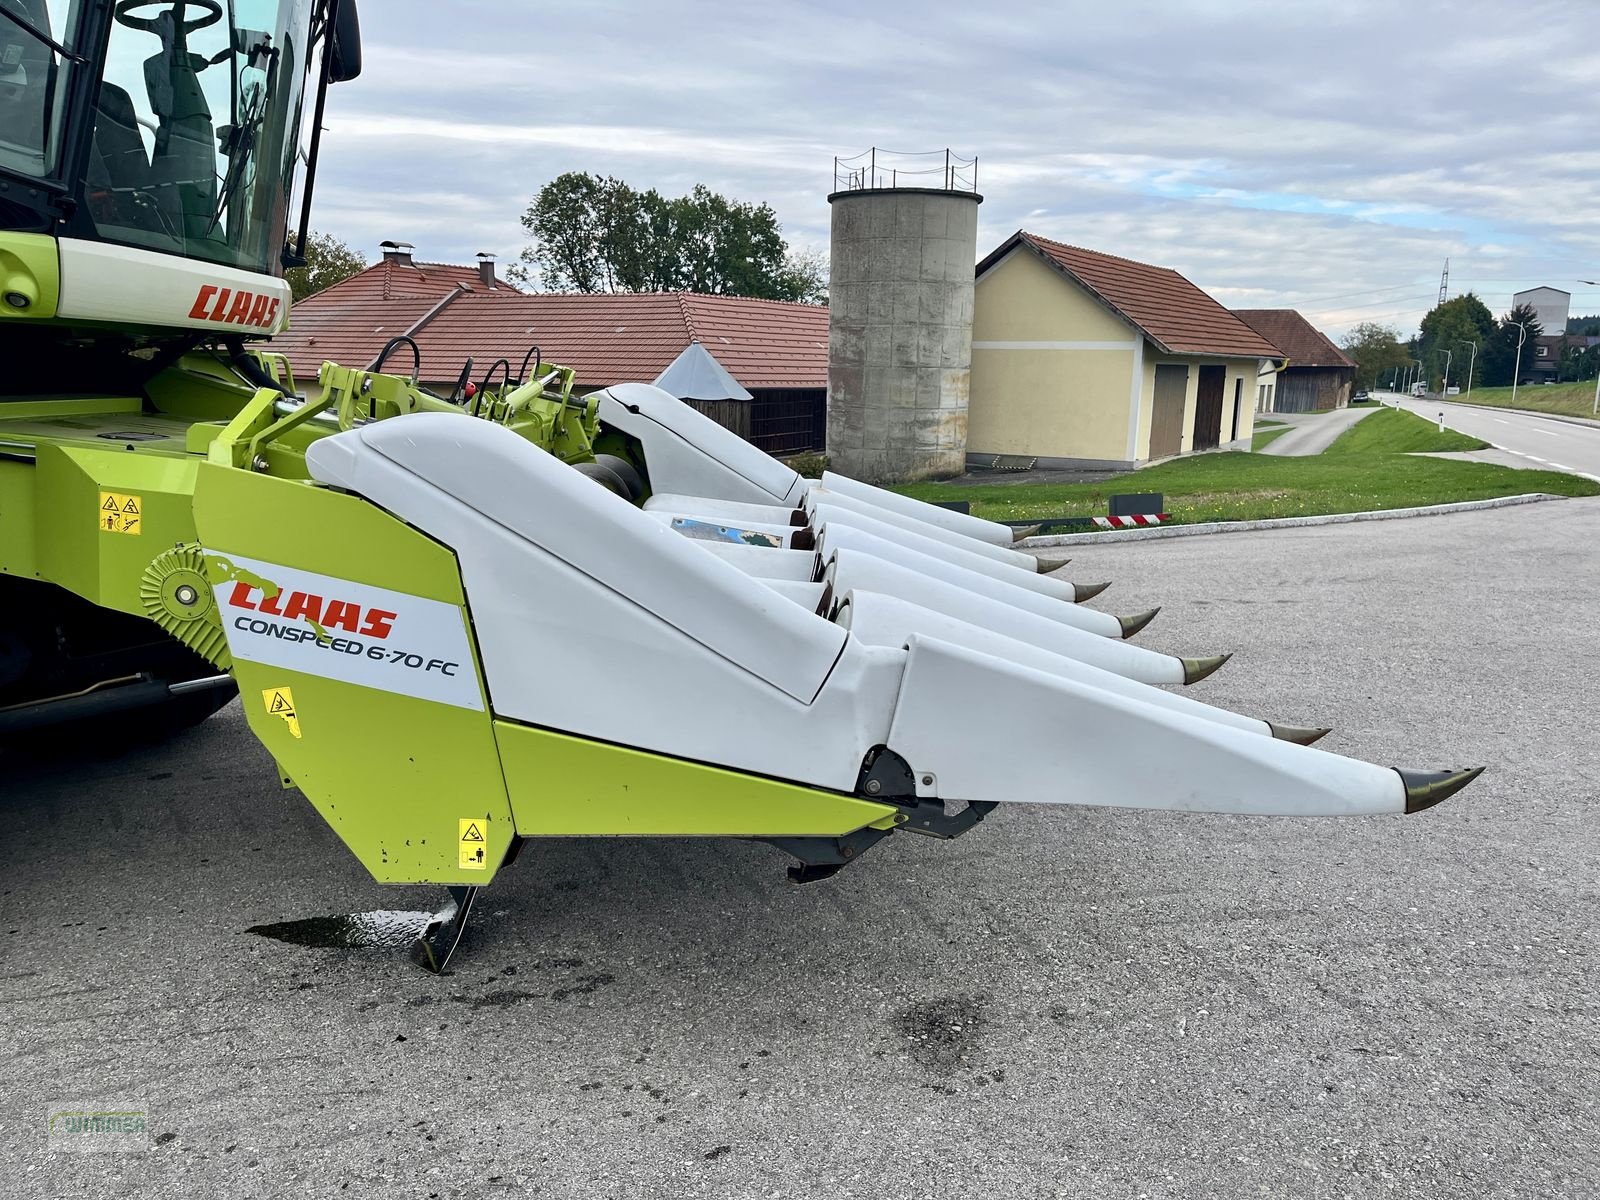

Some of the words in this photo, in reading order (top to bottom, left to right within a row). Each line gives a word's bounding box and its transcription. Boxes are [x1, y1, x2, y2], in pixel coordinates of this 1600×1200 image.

[188, 285, 280, 328] CLAAS
[229, 581, 397, 639] CLAAS
[235, 616, 364, 656] CONSPEED
[425, 658, 459, 676] FC
